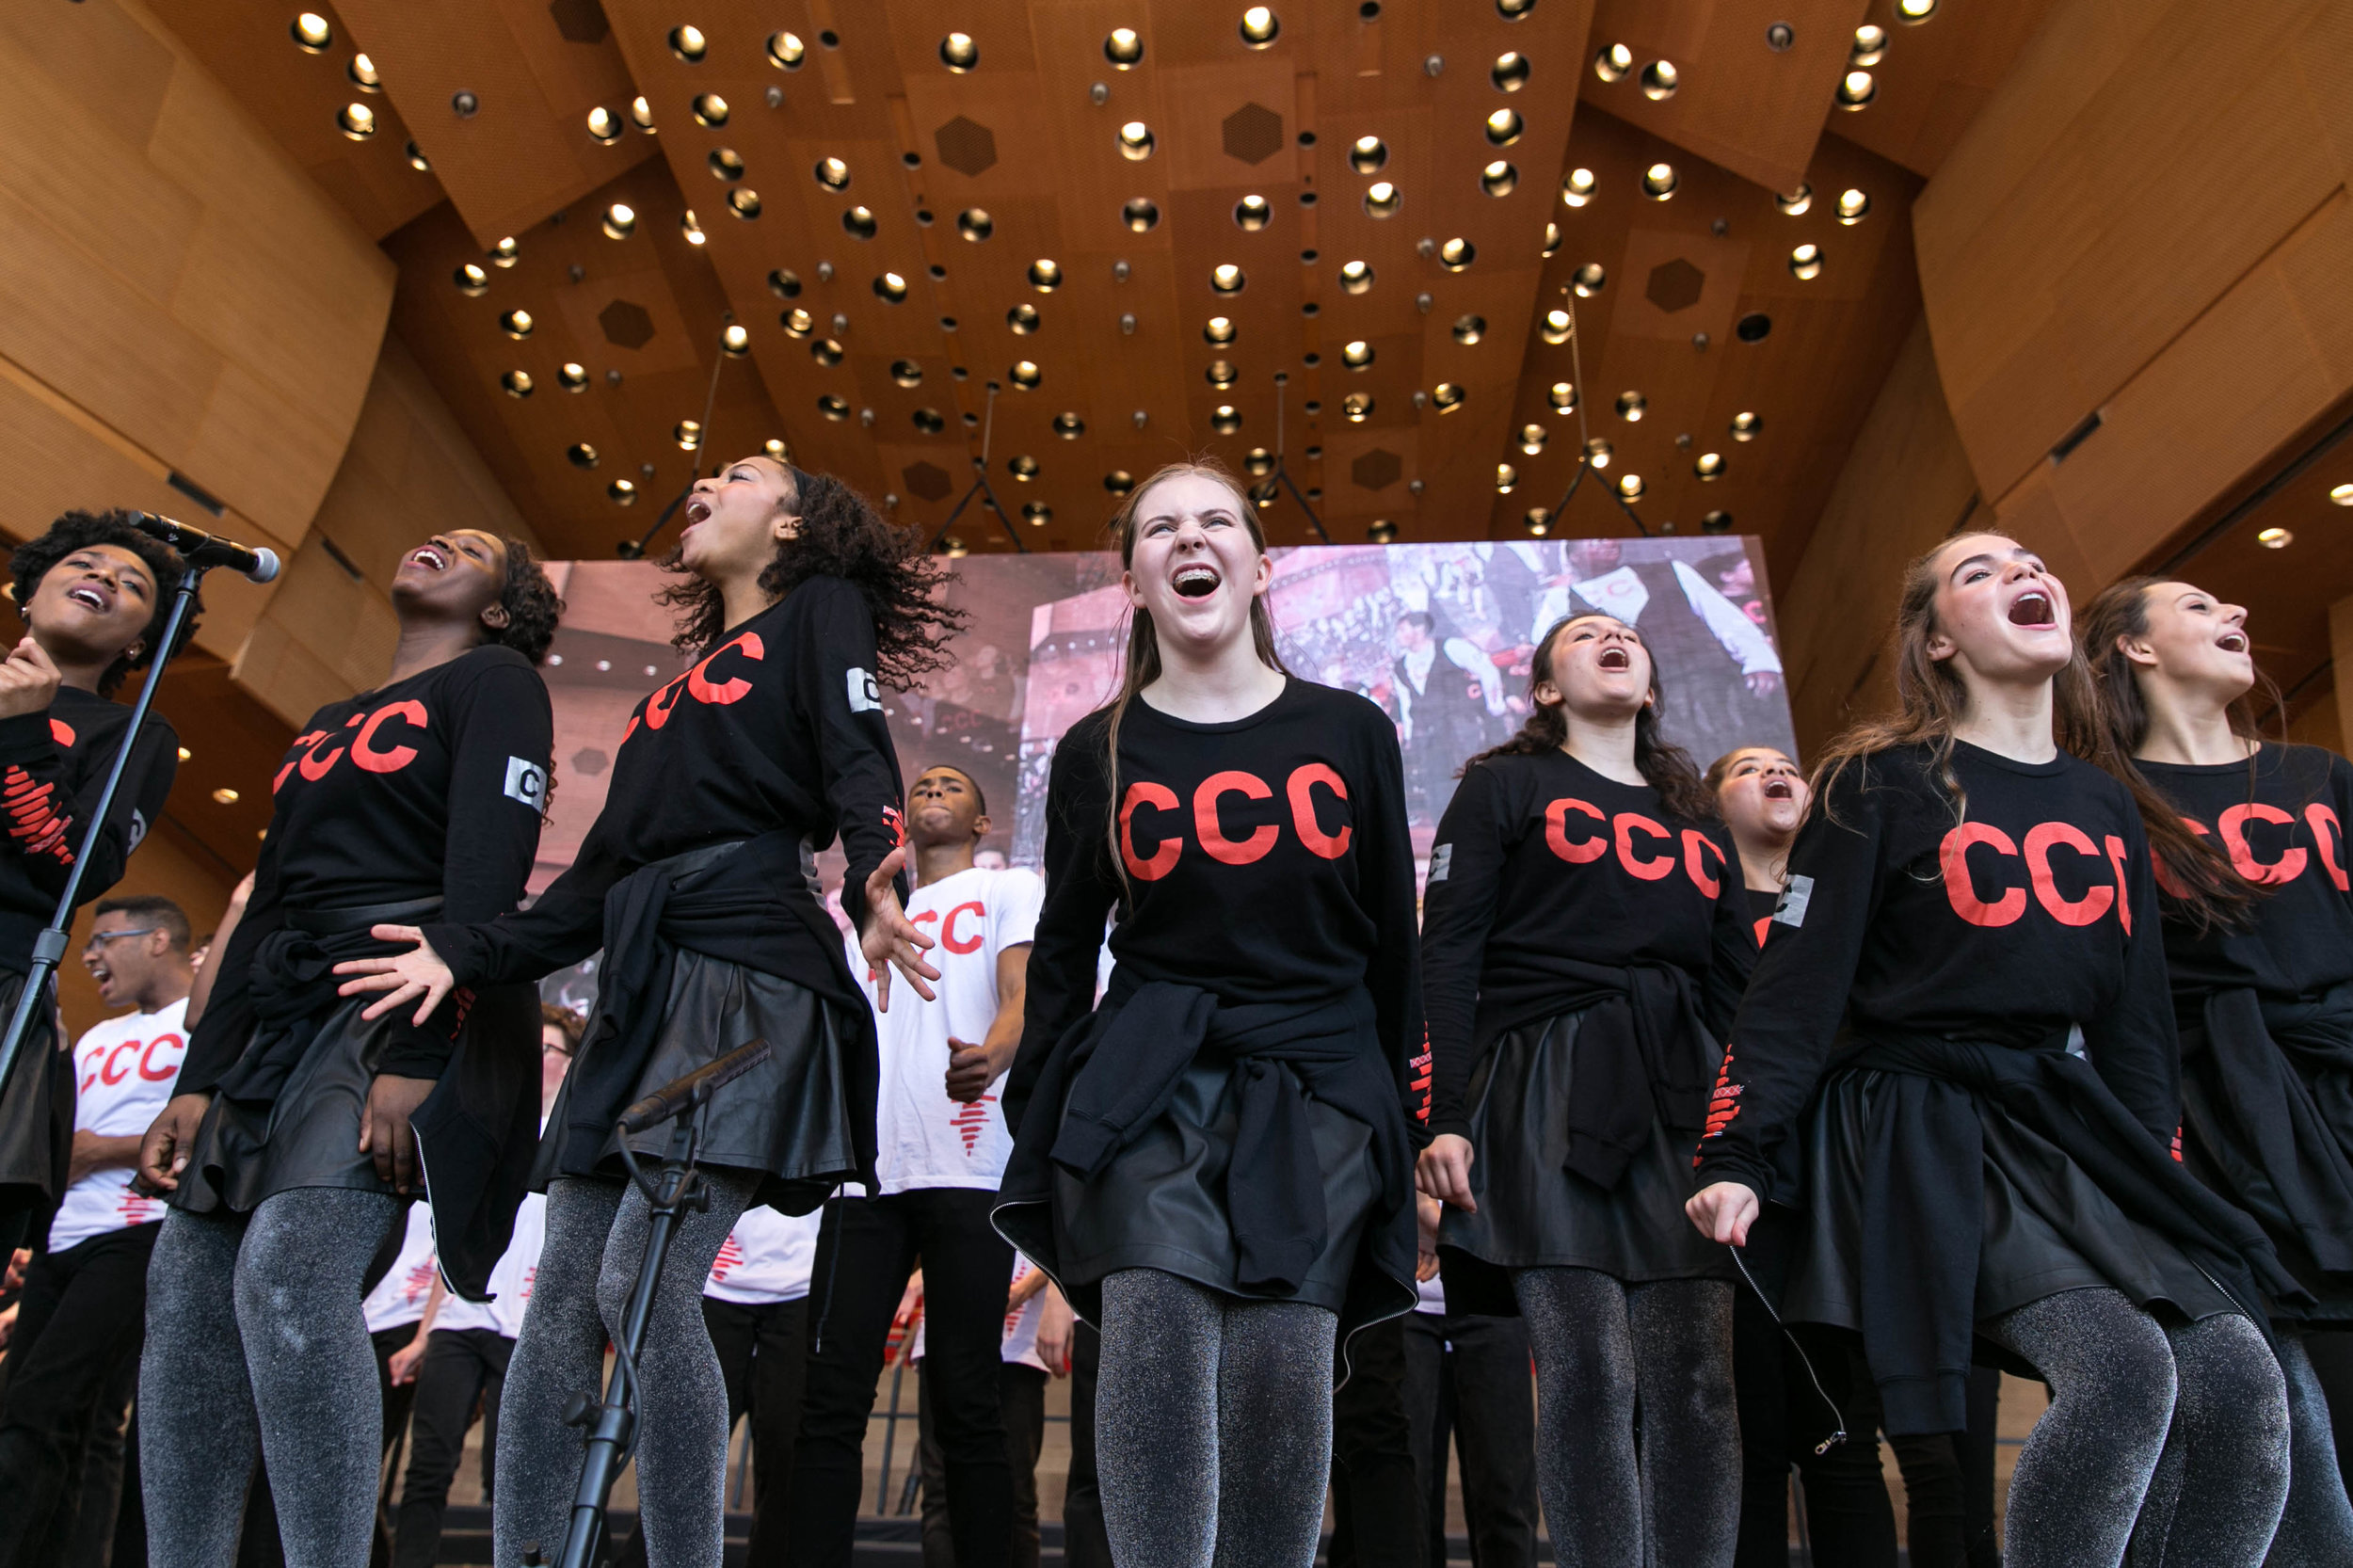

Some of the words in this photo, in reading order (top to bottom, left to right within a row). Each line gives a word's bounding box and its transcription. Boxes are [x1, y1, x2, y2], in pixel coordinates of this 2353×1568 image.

[520, 768, 540, 798] C
[1119, 762, 1353, 881] CCC
[1545, 797, 1728, 900] CCC
[80, 1033, 184, 1096] CCC
